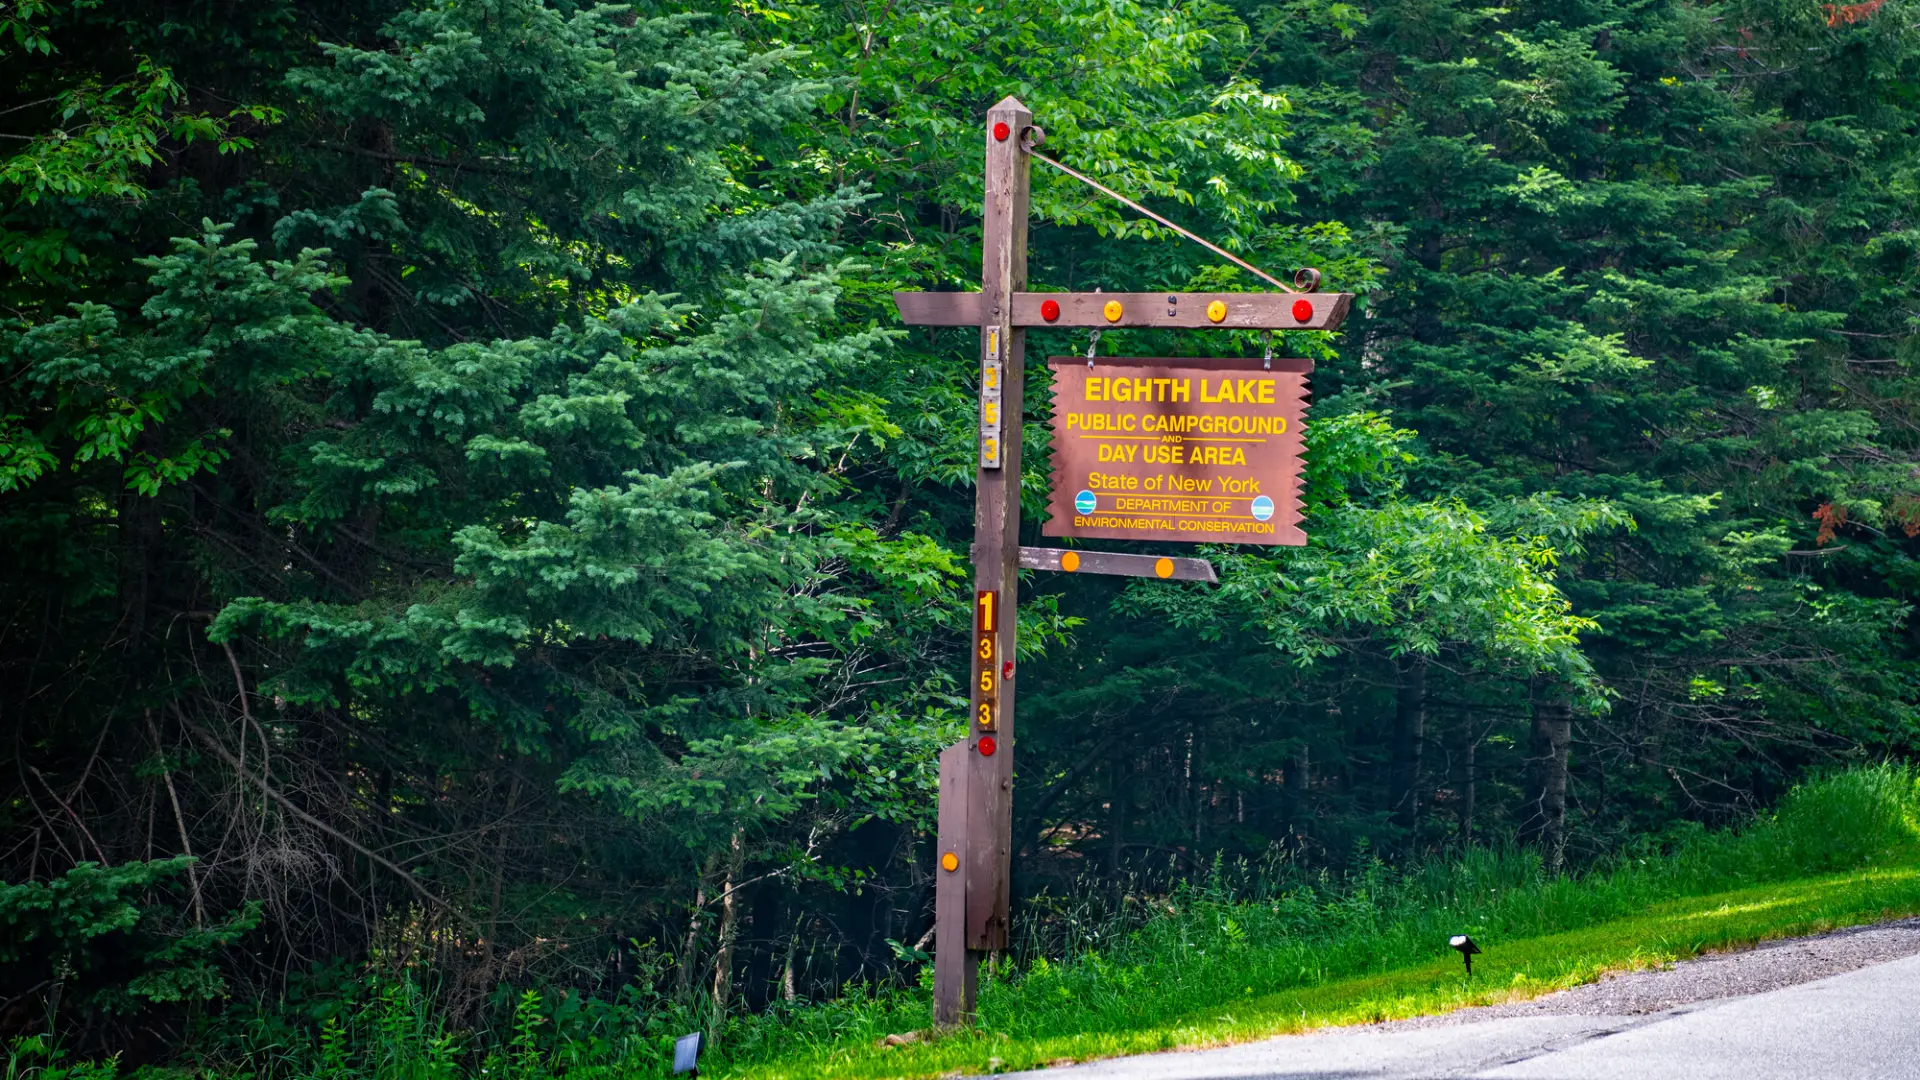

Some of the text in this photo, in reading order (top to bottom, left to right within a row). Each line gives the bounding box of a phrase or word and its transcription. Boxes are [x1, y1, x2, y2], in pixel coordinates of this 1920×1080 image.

[1085, 377, 1276, 404] EIGHTH LAKE
[1067, 413, 1287, 435] PUBLIC CAMPGROUND
[1161, 435, 1182, 443] AND
[1098, 444, 1246, 466] DAY USE AREA
[1088, 472, 1261, 494] State of New York
[1116, 498, 1232, 514] DEPARTMENT OF
[1074, 516, 1275, 534] ENVIRONMENTAL CONSERVATION
[978, 591, 993, 725] 1353
